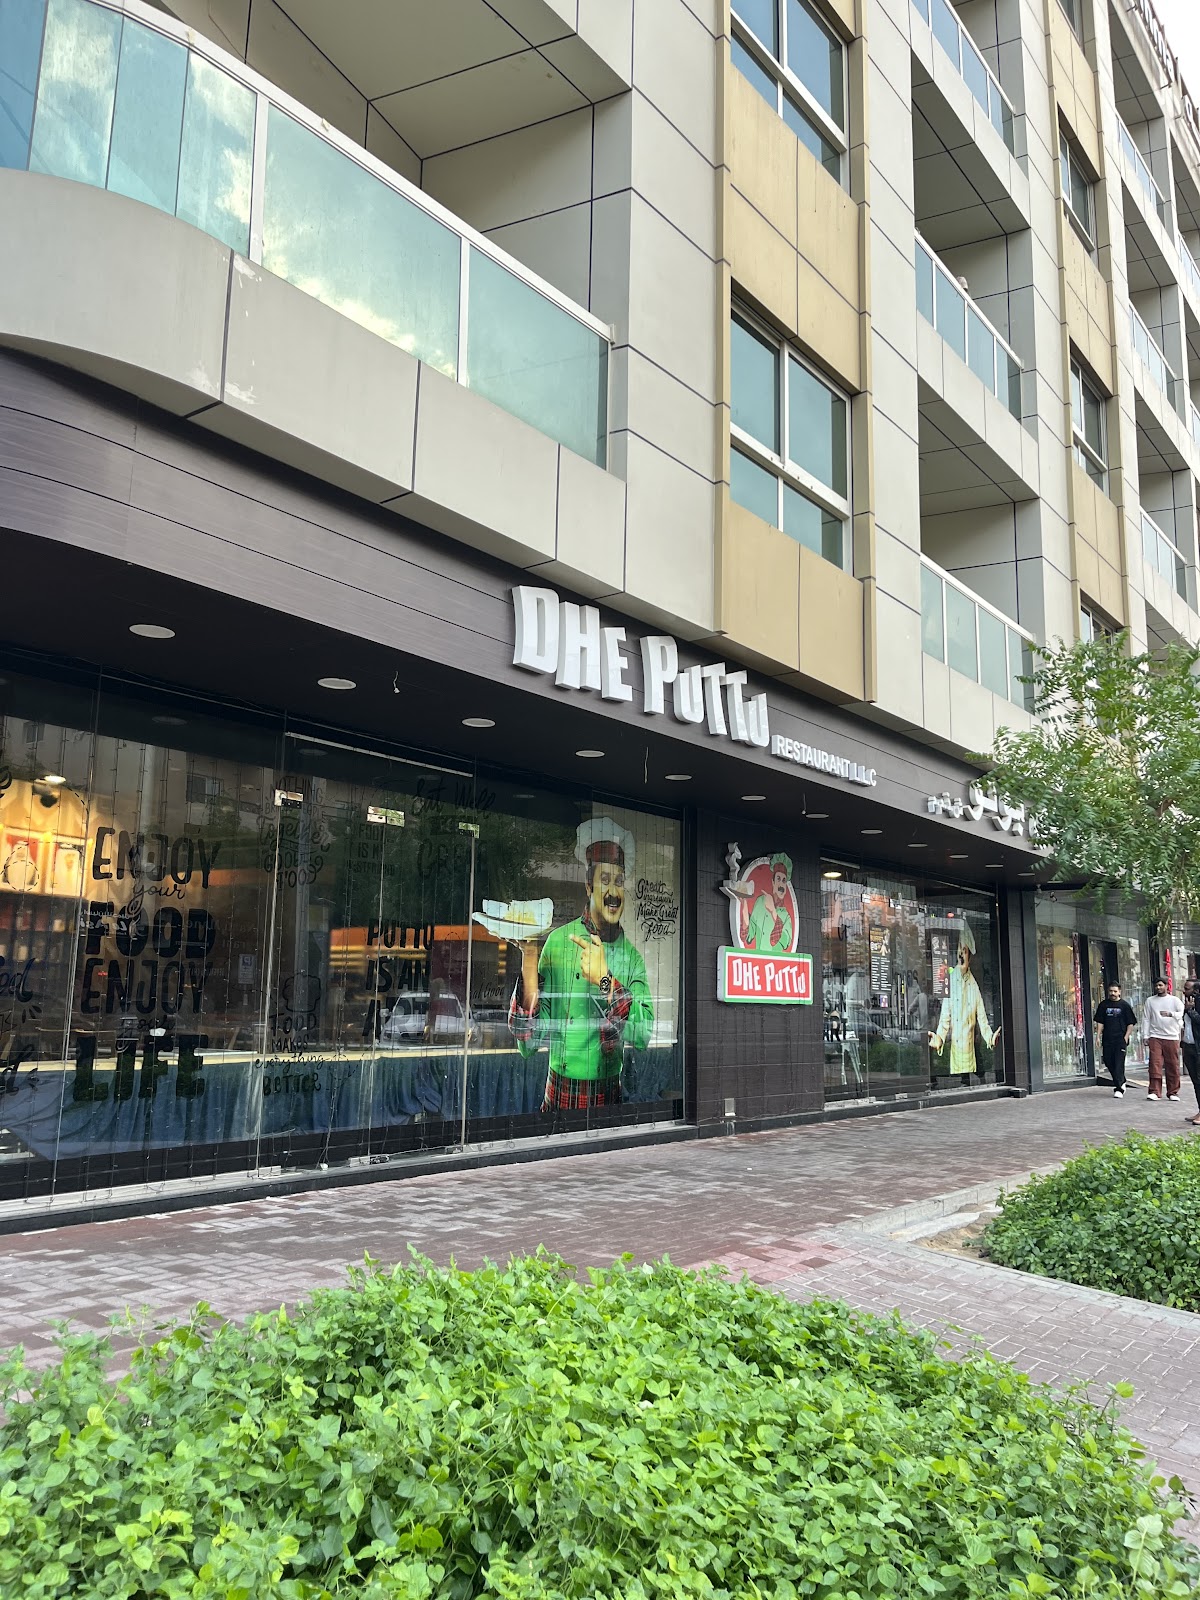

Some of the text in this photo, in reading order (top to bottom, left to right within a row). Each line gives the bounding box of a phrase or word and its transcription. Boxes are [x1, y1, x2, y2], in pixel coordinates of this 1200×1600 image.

[512, 585, 770, 748] DHE PUTTU
[771, 733, 877, 787] RESTAURANT LLC
[92, 826, 222, 889] ENJOY
[126, 883, 186, 920] your
[85, 900, 217, 959] FOOD
[366, 918, 434, 950] PUTTU
[81, 957, 214, 1014] ENJOY
[365, 956, 394, 993] IS
[398, 959, 432, 993] AN
[732, 958, 762, 992] DHE
[72, 1034, 209, 1101] LIFE
